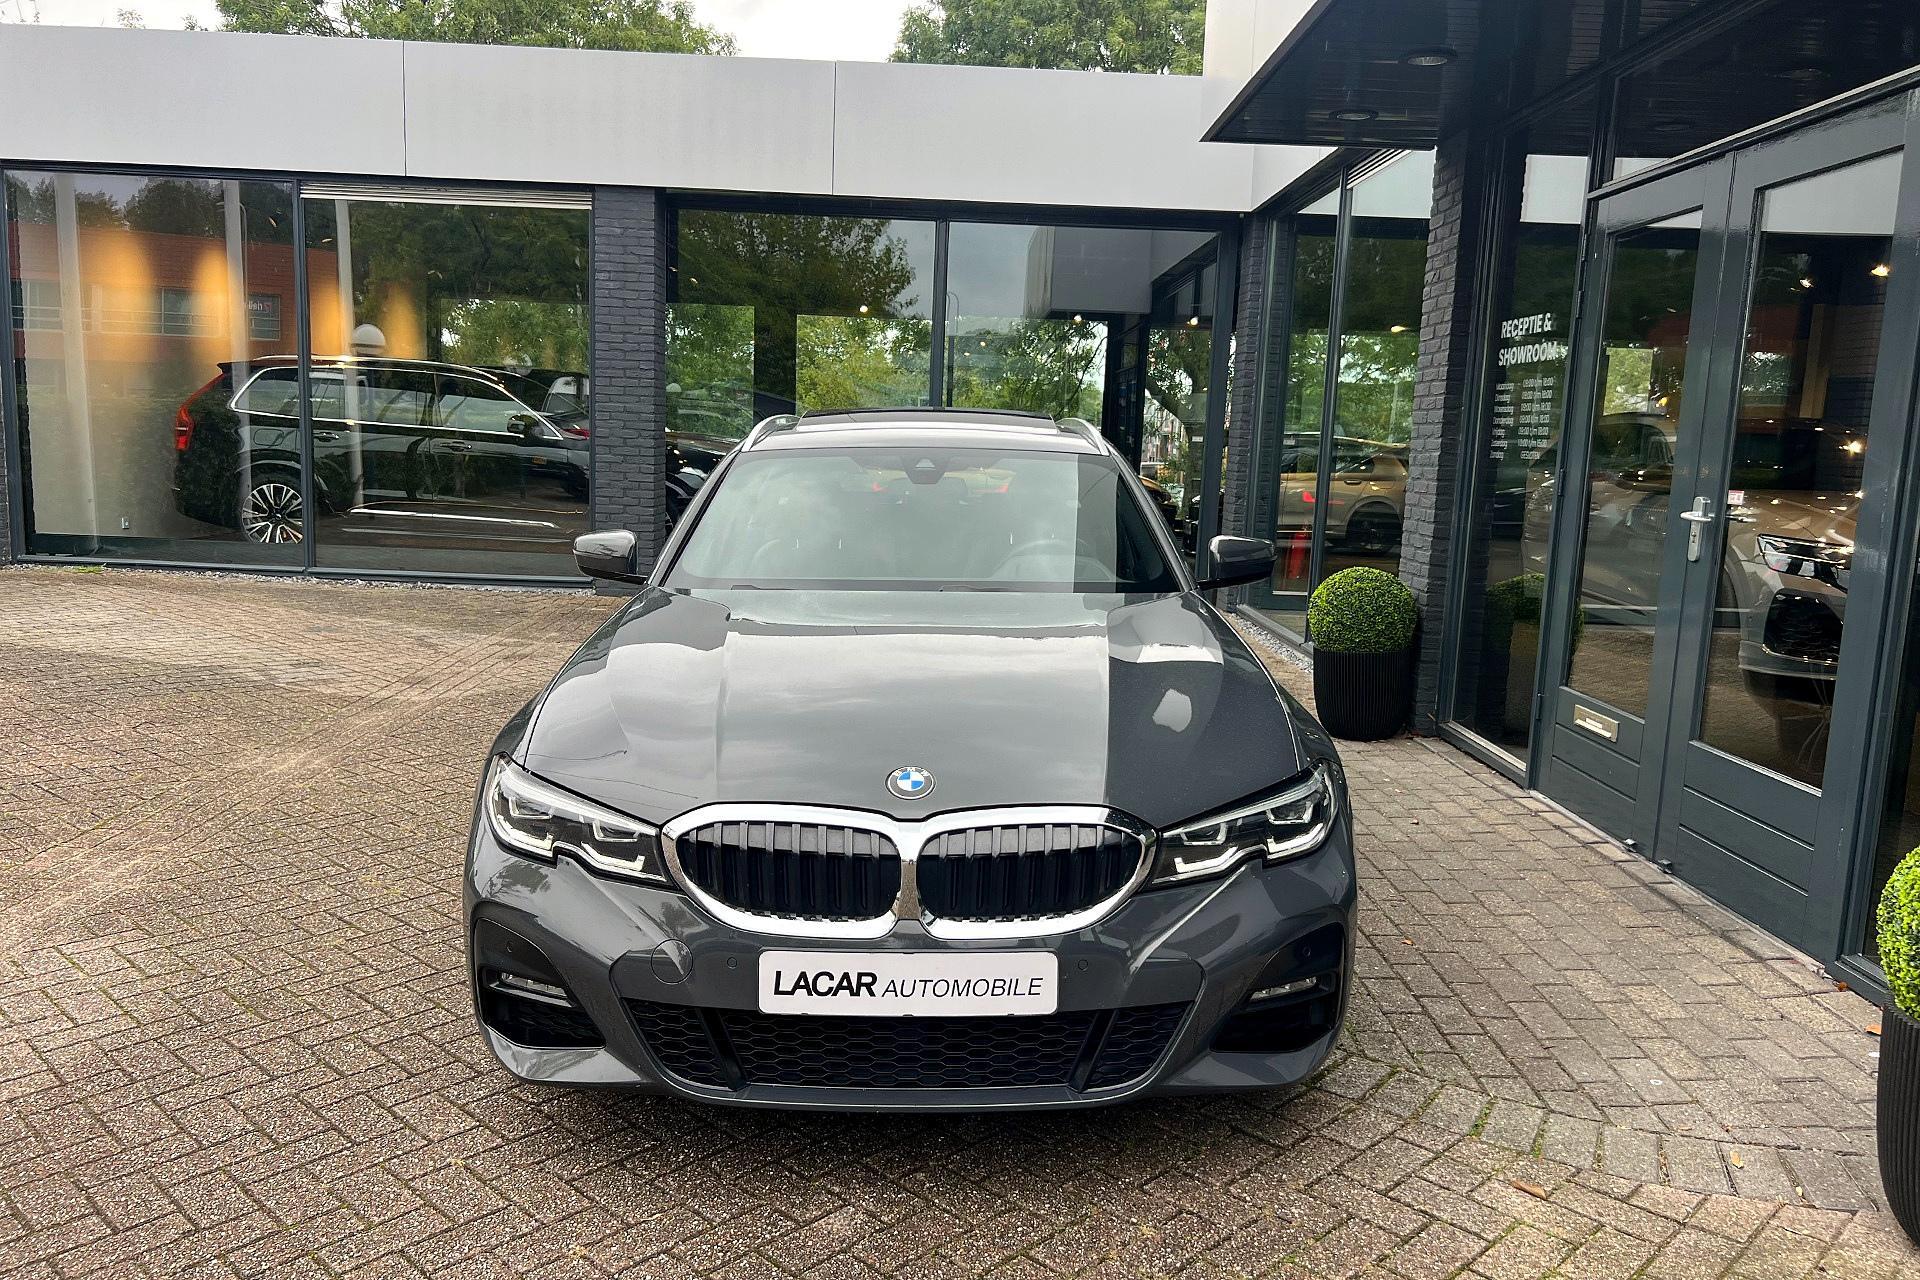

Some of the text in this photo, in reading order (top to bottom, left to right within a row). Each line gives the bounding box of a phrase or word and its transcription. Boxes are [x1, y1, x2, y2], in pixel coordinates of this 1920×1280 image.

[1501, 312, 1552, 339] RECEPTIE &
[1498, 341, 1557, 366] SHOWROOM
[773, 970, 1044, 997] LACAR AUTOMOBILE
